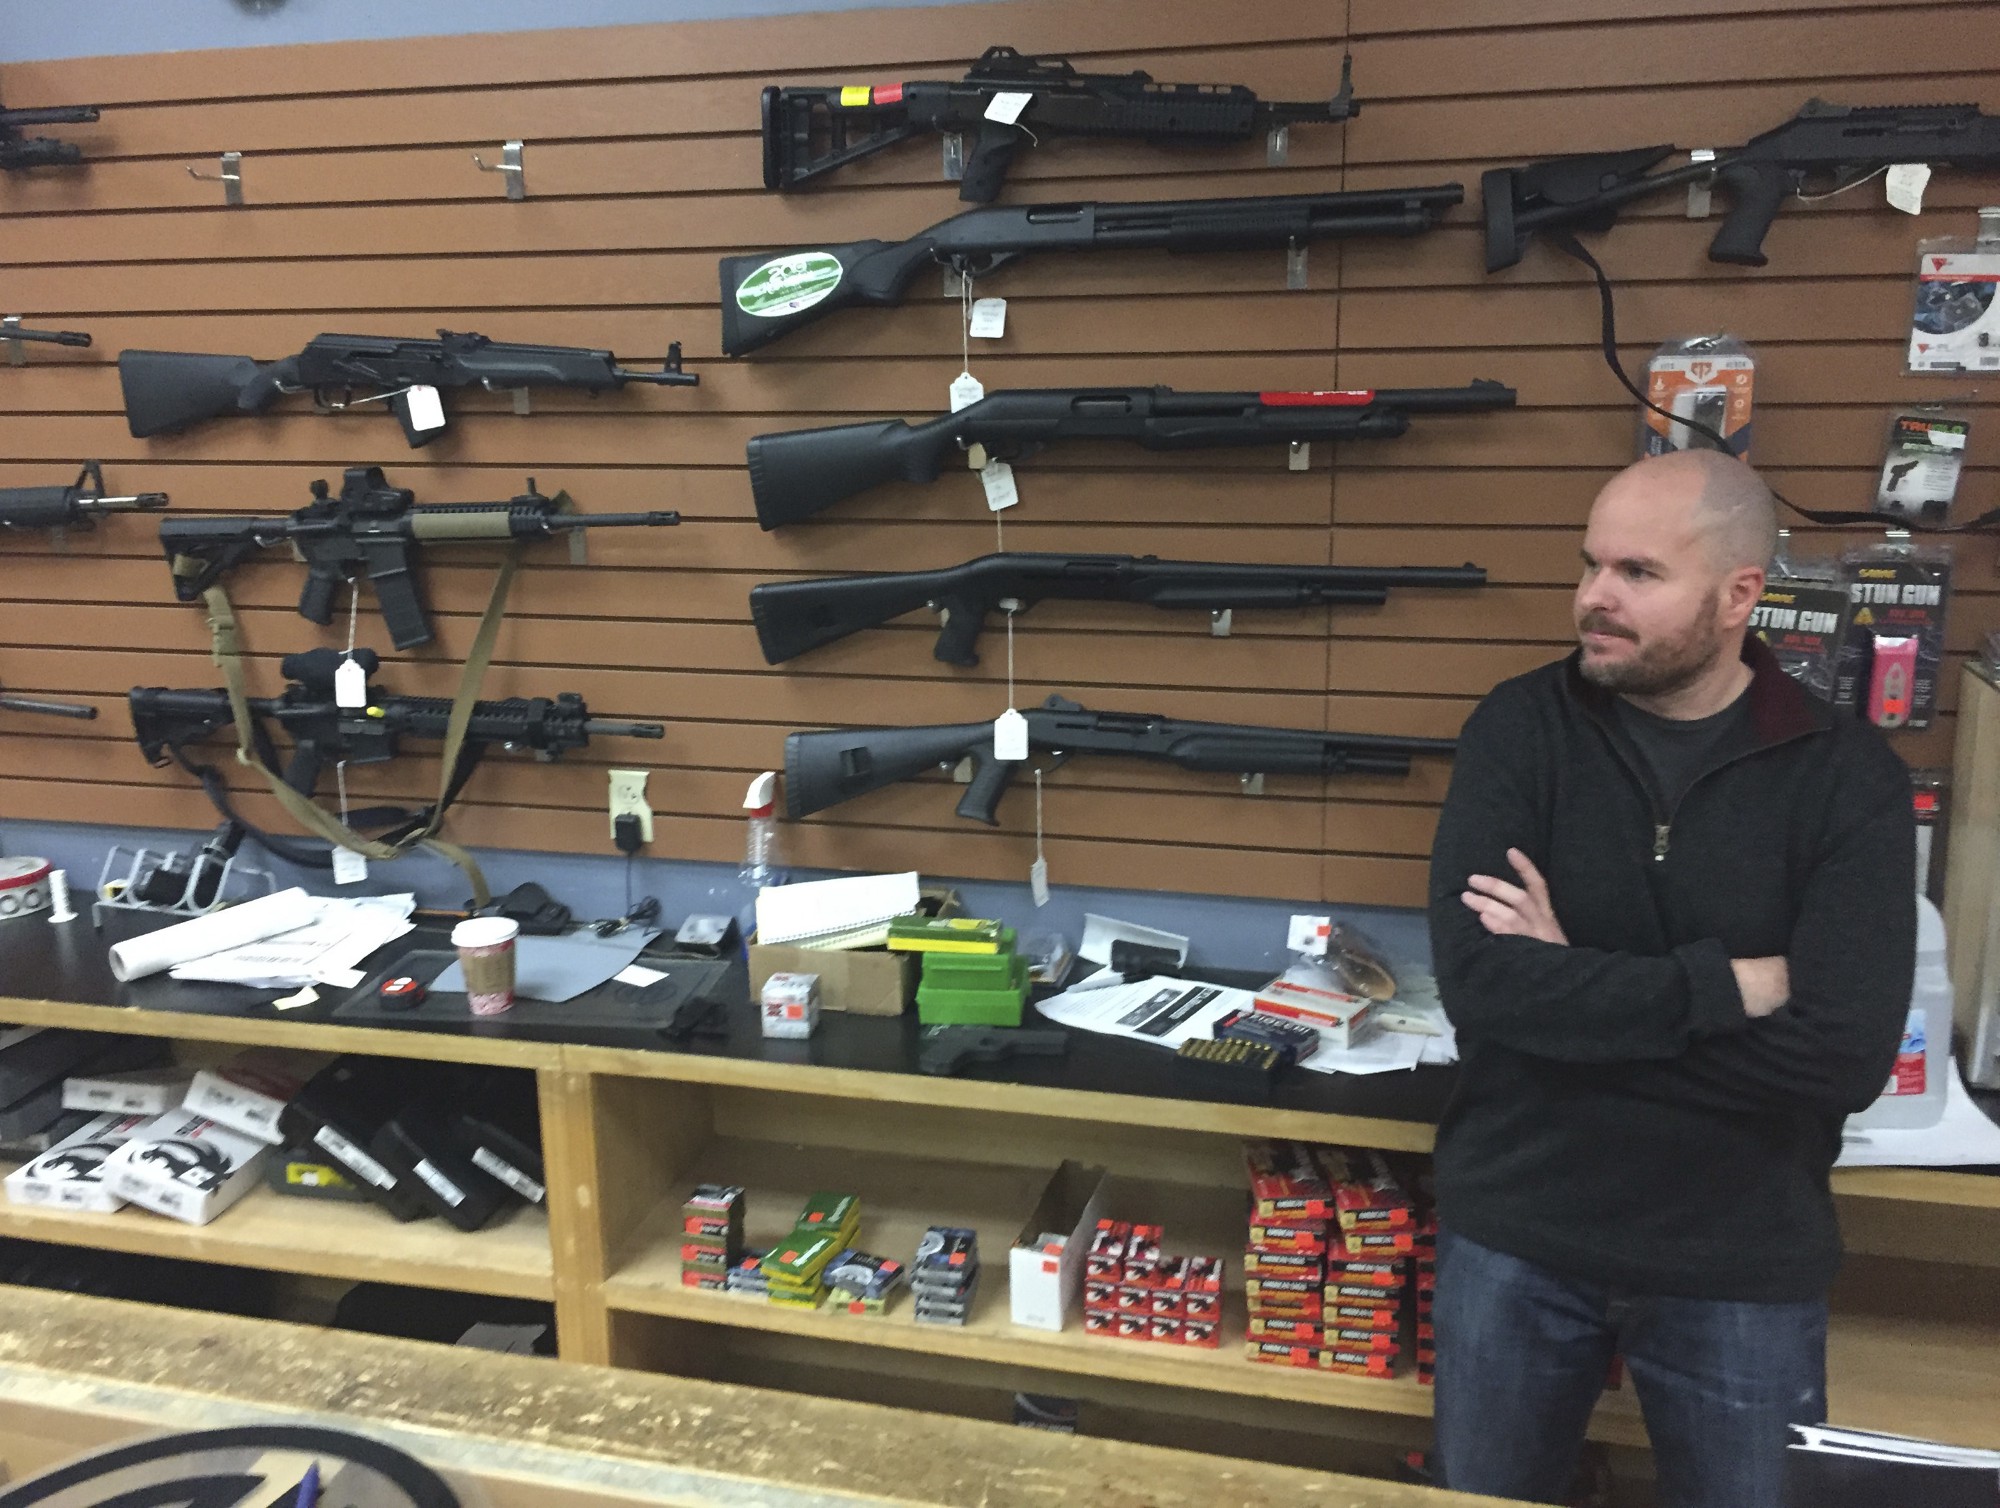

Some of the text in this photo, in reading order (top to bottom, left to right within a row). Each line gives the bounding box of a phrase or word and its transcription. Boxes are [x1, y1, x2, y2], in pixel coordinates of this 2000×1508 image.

[1851, 583, 1941, 606] STUN GUN
[1748, 606, 1839, 634] STUN GUN
